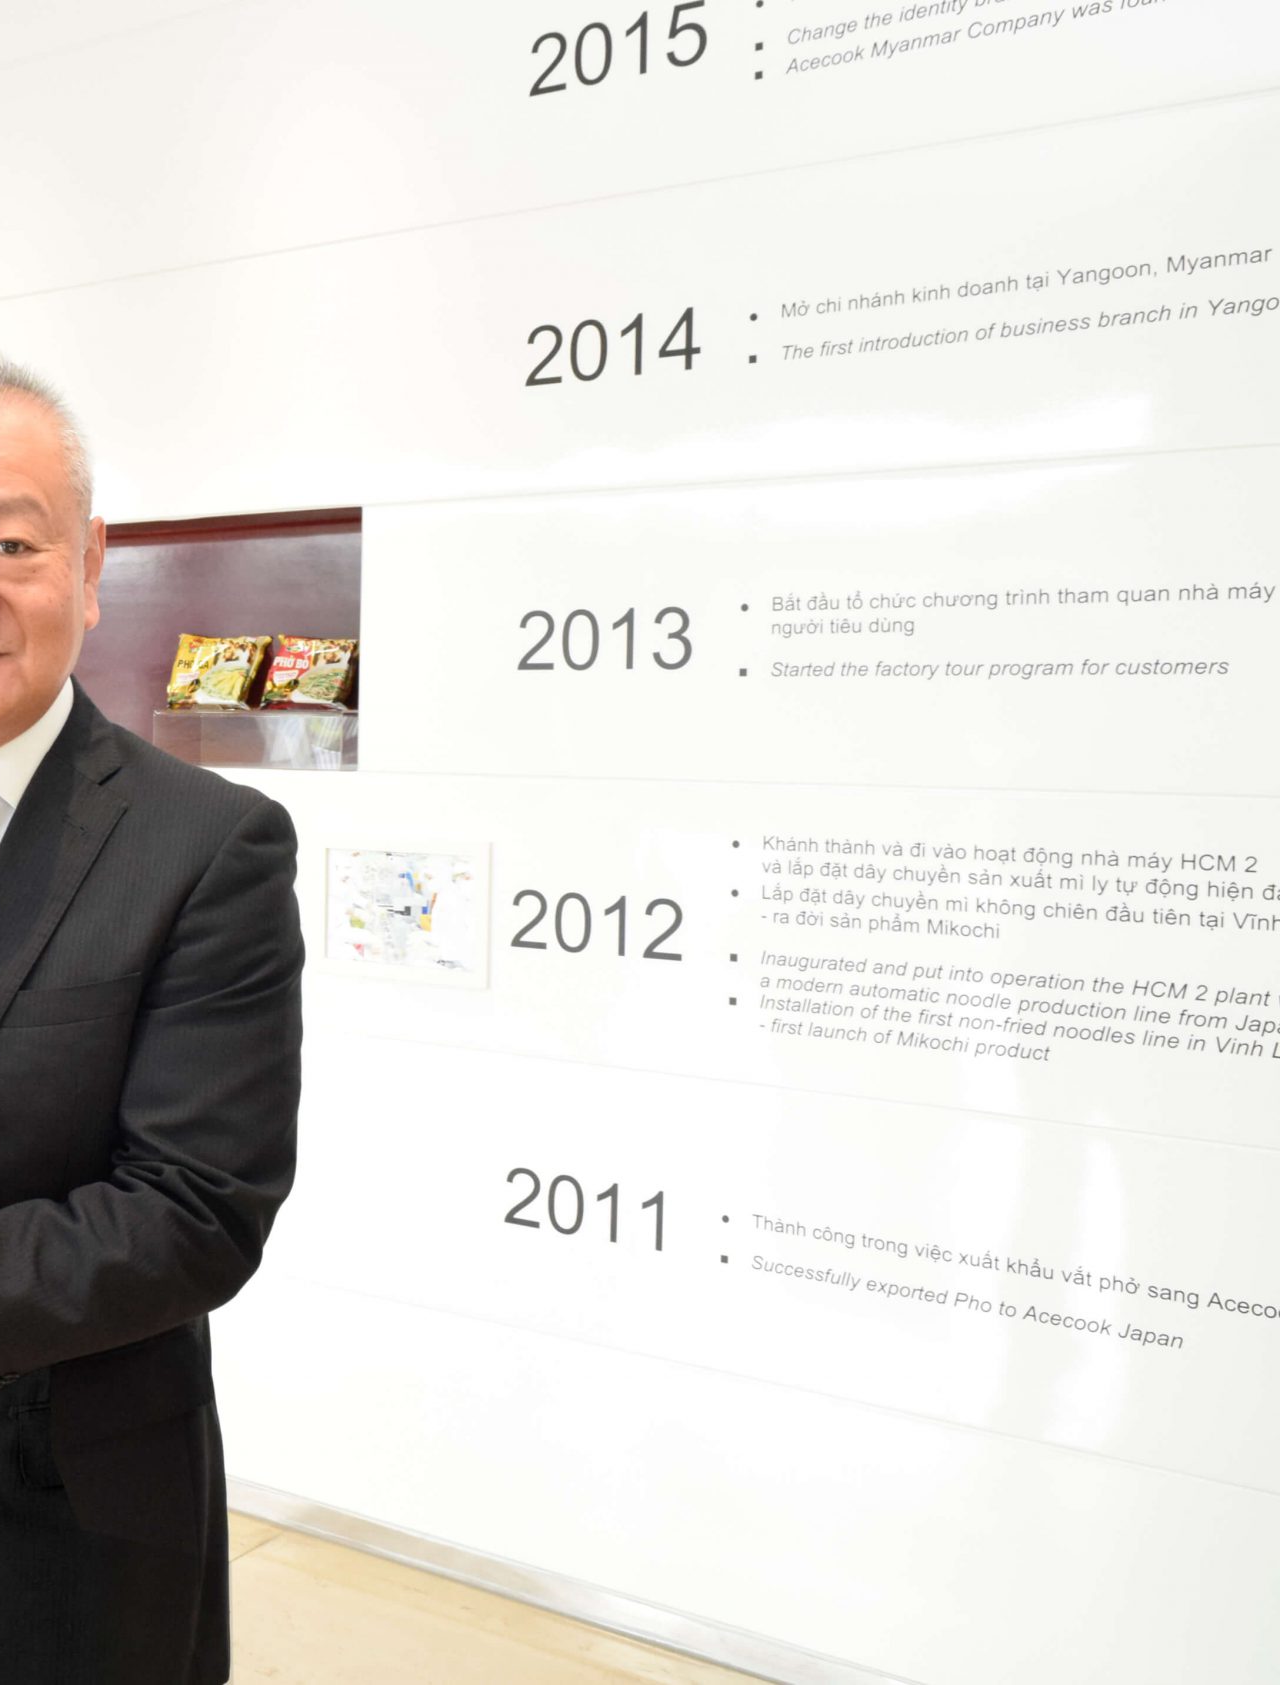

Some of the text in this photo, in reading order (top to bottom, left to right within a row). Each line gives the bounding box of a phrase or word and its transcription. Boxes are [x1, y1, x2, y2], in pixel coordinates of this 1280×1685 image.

[529, 0, 707, 96] 2015
[786, 0, 1113, 75] Acecook Myanmar Company was
[788, 0, 968, 45] Change the identity
[781, 248, 1272, 318] Mở chi nhánh kinh doanh tại Yangoon, Myanmar
[525, 307, 700, 386] 2014
[782, 302, 1198, 361] The first introduction of business branch in
[772, 581, 1275, 612] Bắt đầu tổ chức chương trình tham quan nhà máy
[772, 617, 914, 639] người tiêu dùng
[517, 607, 692, 671] 2013
[771, 659, 1229, 680] Started the factory tour program for customers
[763, 835, 1257, 874] Khánh thành và đi vào hoạt động nhà máy HCM 2
[510, 890, 682, 961] 2012
[762, 883, 1280, 932] Lắp đặt dây chuyền mì không chiên đầu tiên tại Vĩnh
[761, 950, 1271, 1007] Inaugurated and put into operation the HCM 2 plant
[760, 994, 1263, 1057] Installation of the first non-fried noodles line in Vinh
[503, 1168, 663, 1251] 2011
[752, 1214, 1199, 1310] Thành công trong việc xuất khẩu vắt phở sang
[752, 1255, 1183, 1349] Successfully exported Pho to Acecook Japan
